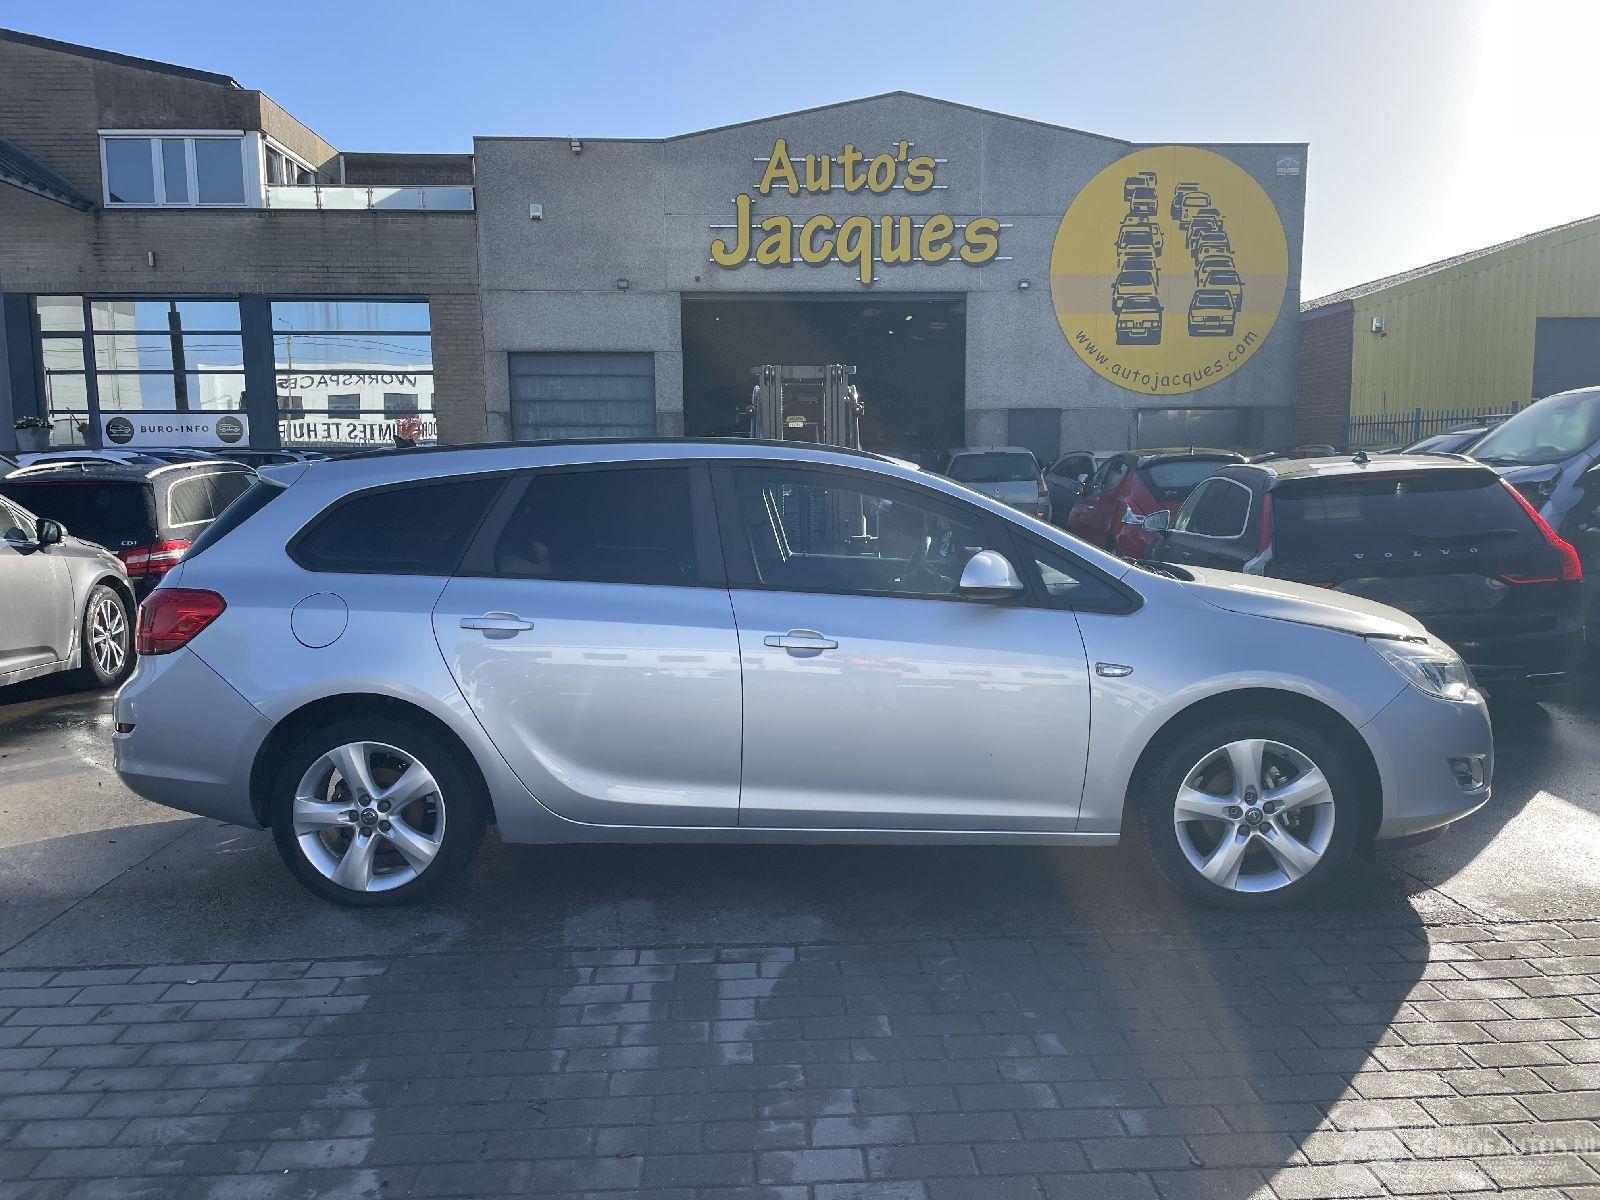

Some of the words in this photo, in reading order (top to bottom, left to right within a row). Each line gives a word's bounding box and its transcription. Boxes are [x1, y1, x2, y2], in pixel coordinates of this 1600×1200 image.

[759, 138, 936, 194] Auto's
[710, 194, 1000, 284] Jacques
[1075, 330, 1258, 391] www.autojacques.com
[140, 425, 209, 434] BURO-INFO
